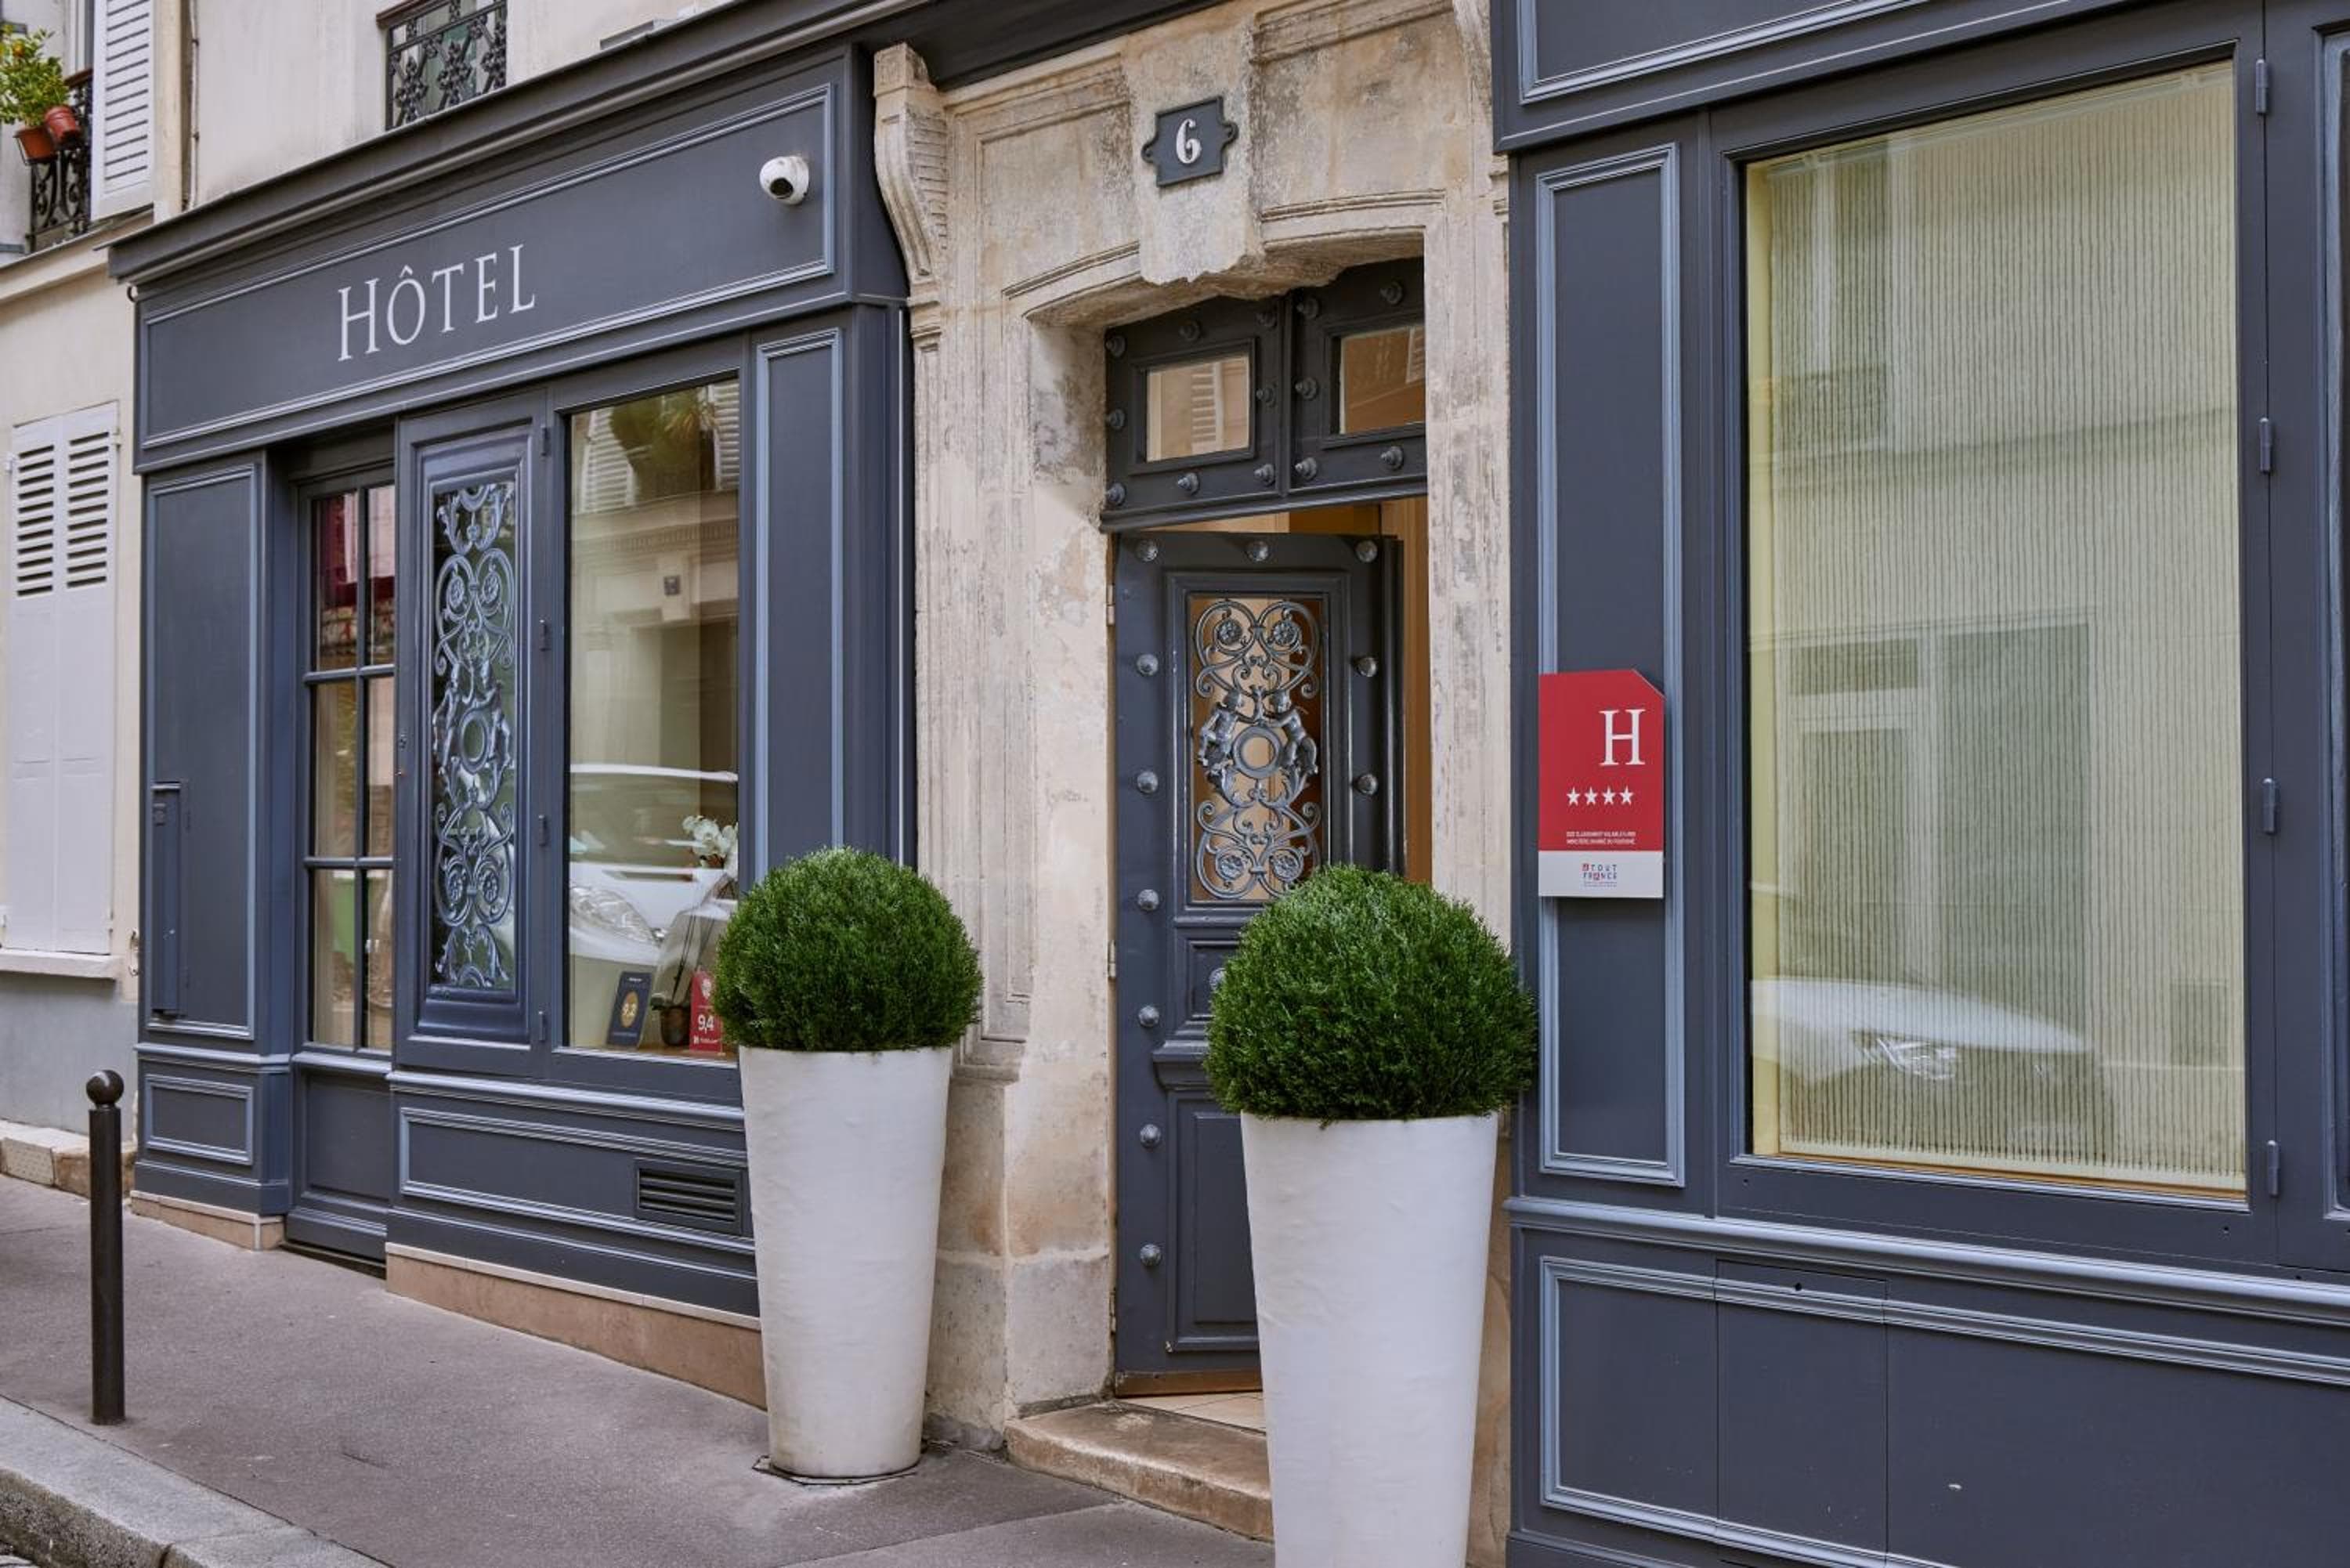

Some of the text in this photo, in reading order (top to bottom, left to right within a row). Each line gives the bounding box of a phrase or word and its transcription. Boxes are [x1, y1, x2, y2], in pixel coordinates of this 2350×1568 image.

[1176, 118, 1202, 164] 6
[338, 244, 535, 361] HÔTEL
[1598, 708, 1646, 767] H
